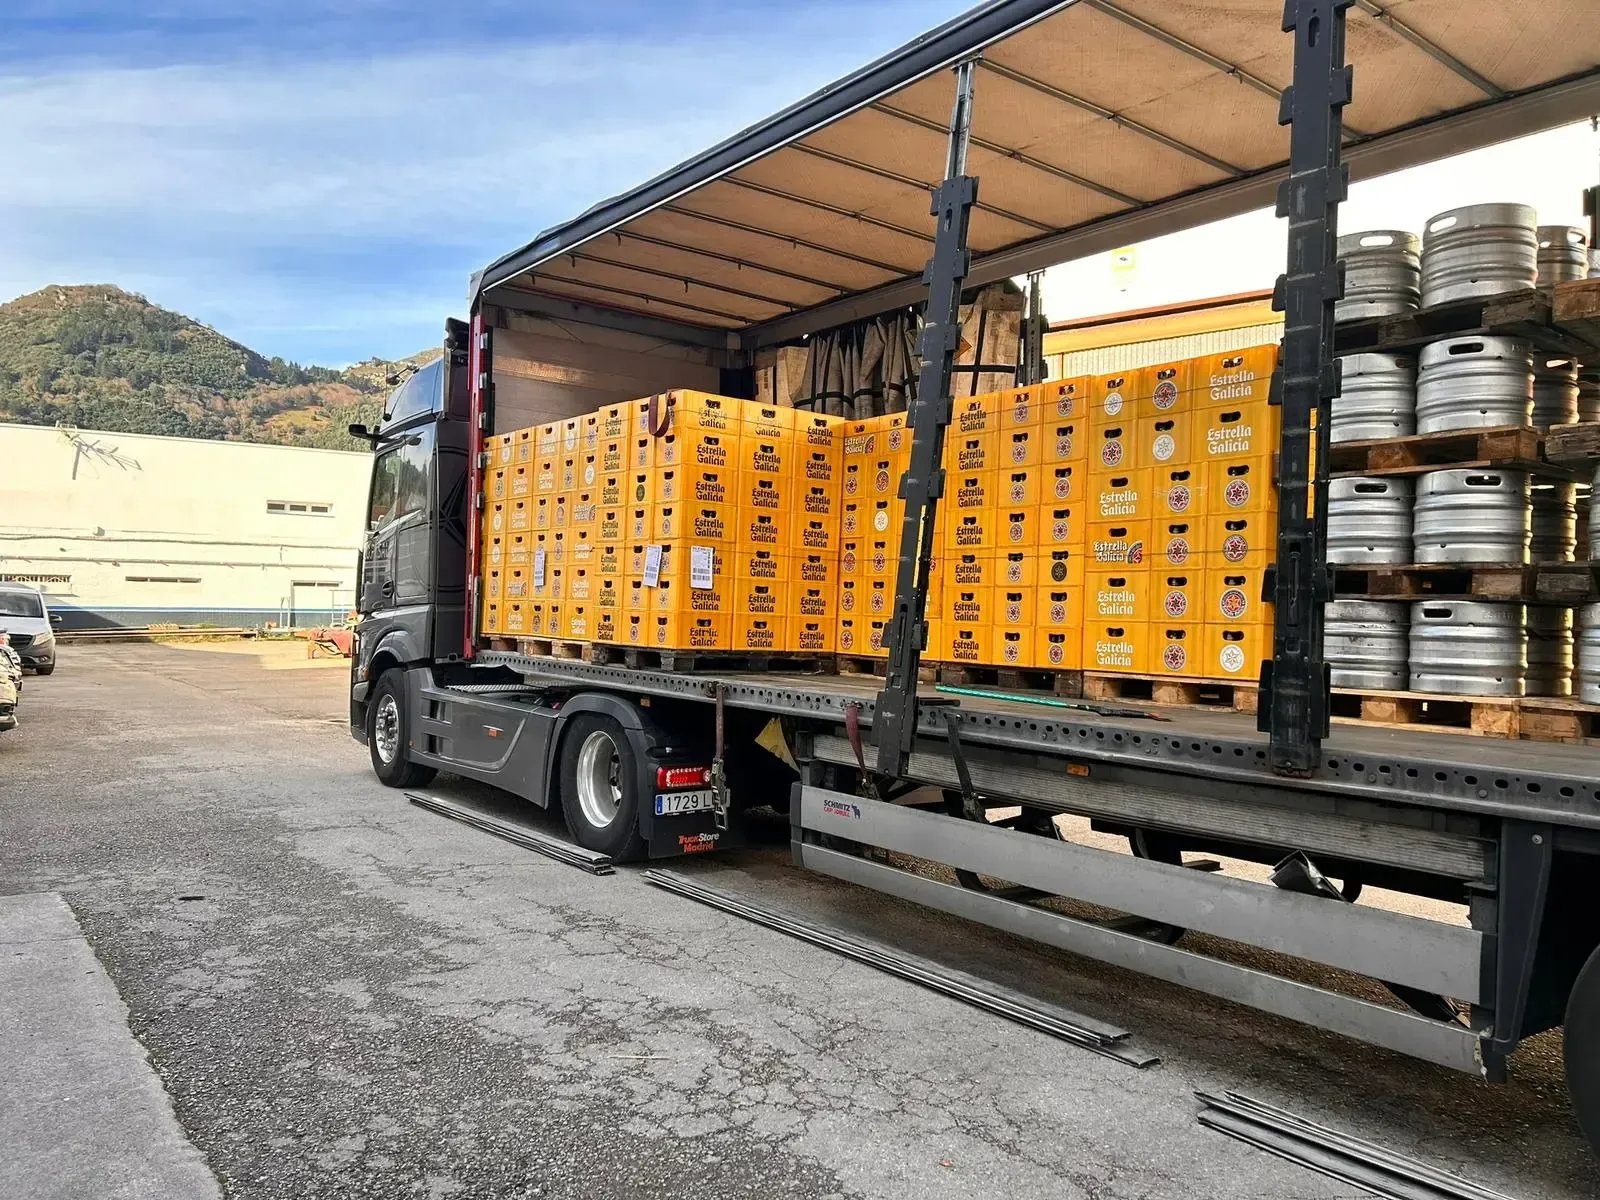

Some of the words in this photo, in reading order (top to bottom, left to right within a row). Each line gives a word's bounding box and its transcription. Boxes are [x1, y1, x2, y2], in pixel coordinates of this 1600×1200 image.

[1210, 370, 1254, 387] Estrella
[1210, 384, 1252, 400] Galicia
[960, 410, 986, 422] Estrella
[699, 418, 726, 430] Galicia
[961, 421, 984, 432] Galicia
[808, 426, 832, 437] Estrella
[1207, 425, 1252, 441] Estrella
[808, 435, 831, 446] Galicia
[697, 444, 726, 457] Estrella
[1208, 439, 1249, 454] Galicia
[697, 454, 724, 466] Galicia
[753, 452, 780, 464] Estrella
[959, 450, 984, 460] Estrella
[754, 461, 779, 472] Galicia
[806, 461, 831, 471] Estrella
[960, 460, 983, 470] Galicia
[807, 470, 830, 480] Galicia
[696, 481, 725, 492] Estrella
[696, 491, 723, 502] Galicia
[752, 488, 779, 499] Estrella
[958, 487, 984, 498] Estrella
[1100, 490, 1137, 504] Estrella
[753, 497, 778, 508] Galicia
[805, 495, 830, 505] Estrella
[958, 497, 982, 508] Galicia
[805, 503, 828, 514] Galicia
[1100, 502, 1135, 516] Galicia
[695, 518, 724, 528] Estrella
[751, 523, 778, 534] Estrella
[695, 527, 722, 538] Galicia
[804, 529, 828, 539] Estrella
[956, 526, 982, 535] Estrella
[751, 533, 776, 543] Galicia
[804, 538, 827, 548] Galicia
[957, 536, 981, 545] Galicia
[1094, 541, 1127, 551] Estrella
[750, 559, 777, 569] Estrella
[802, 563, 826, 573] Estrella
[956, 564, 981, 573] Estrella
[750, 568, 775, 578] Galicia
[802, 572, 825, 581] Galicia
[956, 574, 980, 584] Galicia
[692, 591, 720, 602] Estrella
[748, 594, 775, 604] Estrella
[801, 597, 826, 606] Estrella
[1098, 590, 1135, 602] Estrella
[692, 601, 718, 611] Galicia
[749, 603, 774, 613] Galicia
[801, 606, 824, 615] Galicia
[954, 602, 980, 611] Estrella
[1099, 603, 1133, 615] Galicia
[954, 612, 978, 622] Galicia
[747, 630, 773, 639] Estrella
[800, 632, 824, 641] Estrella
[747, 638, 772, 648] Galicia
[800, 640, 823, 649] Galicia
[953, 640, 979, 650] Estrella
[1096, 640, 1133, 654] Estrella
[953, 649, 977, 660] Galicia
[1097, 653, 1131, 666] Galicia
[667, 794, 699, 811] 1729
[824, 800, 850, 811] SCHMITZ
[679, 833, 719, 844] TruckStore
[684, 841, 714, 853] Madrid
